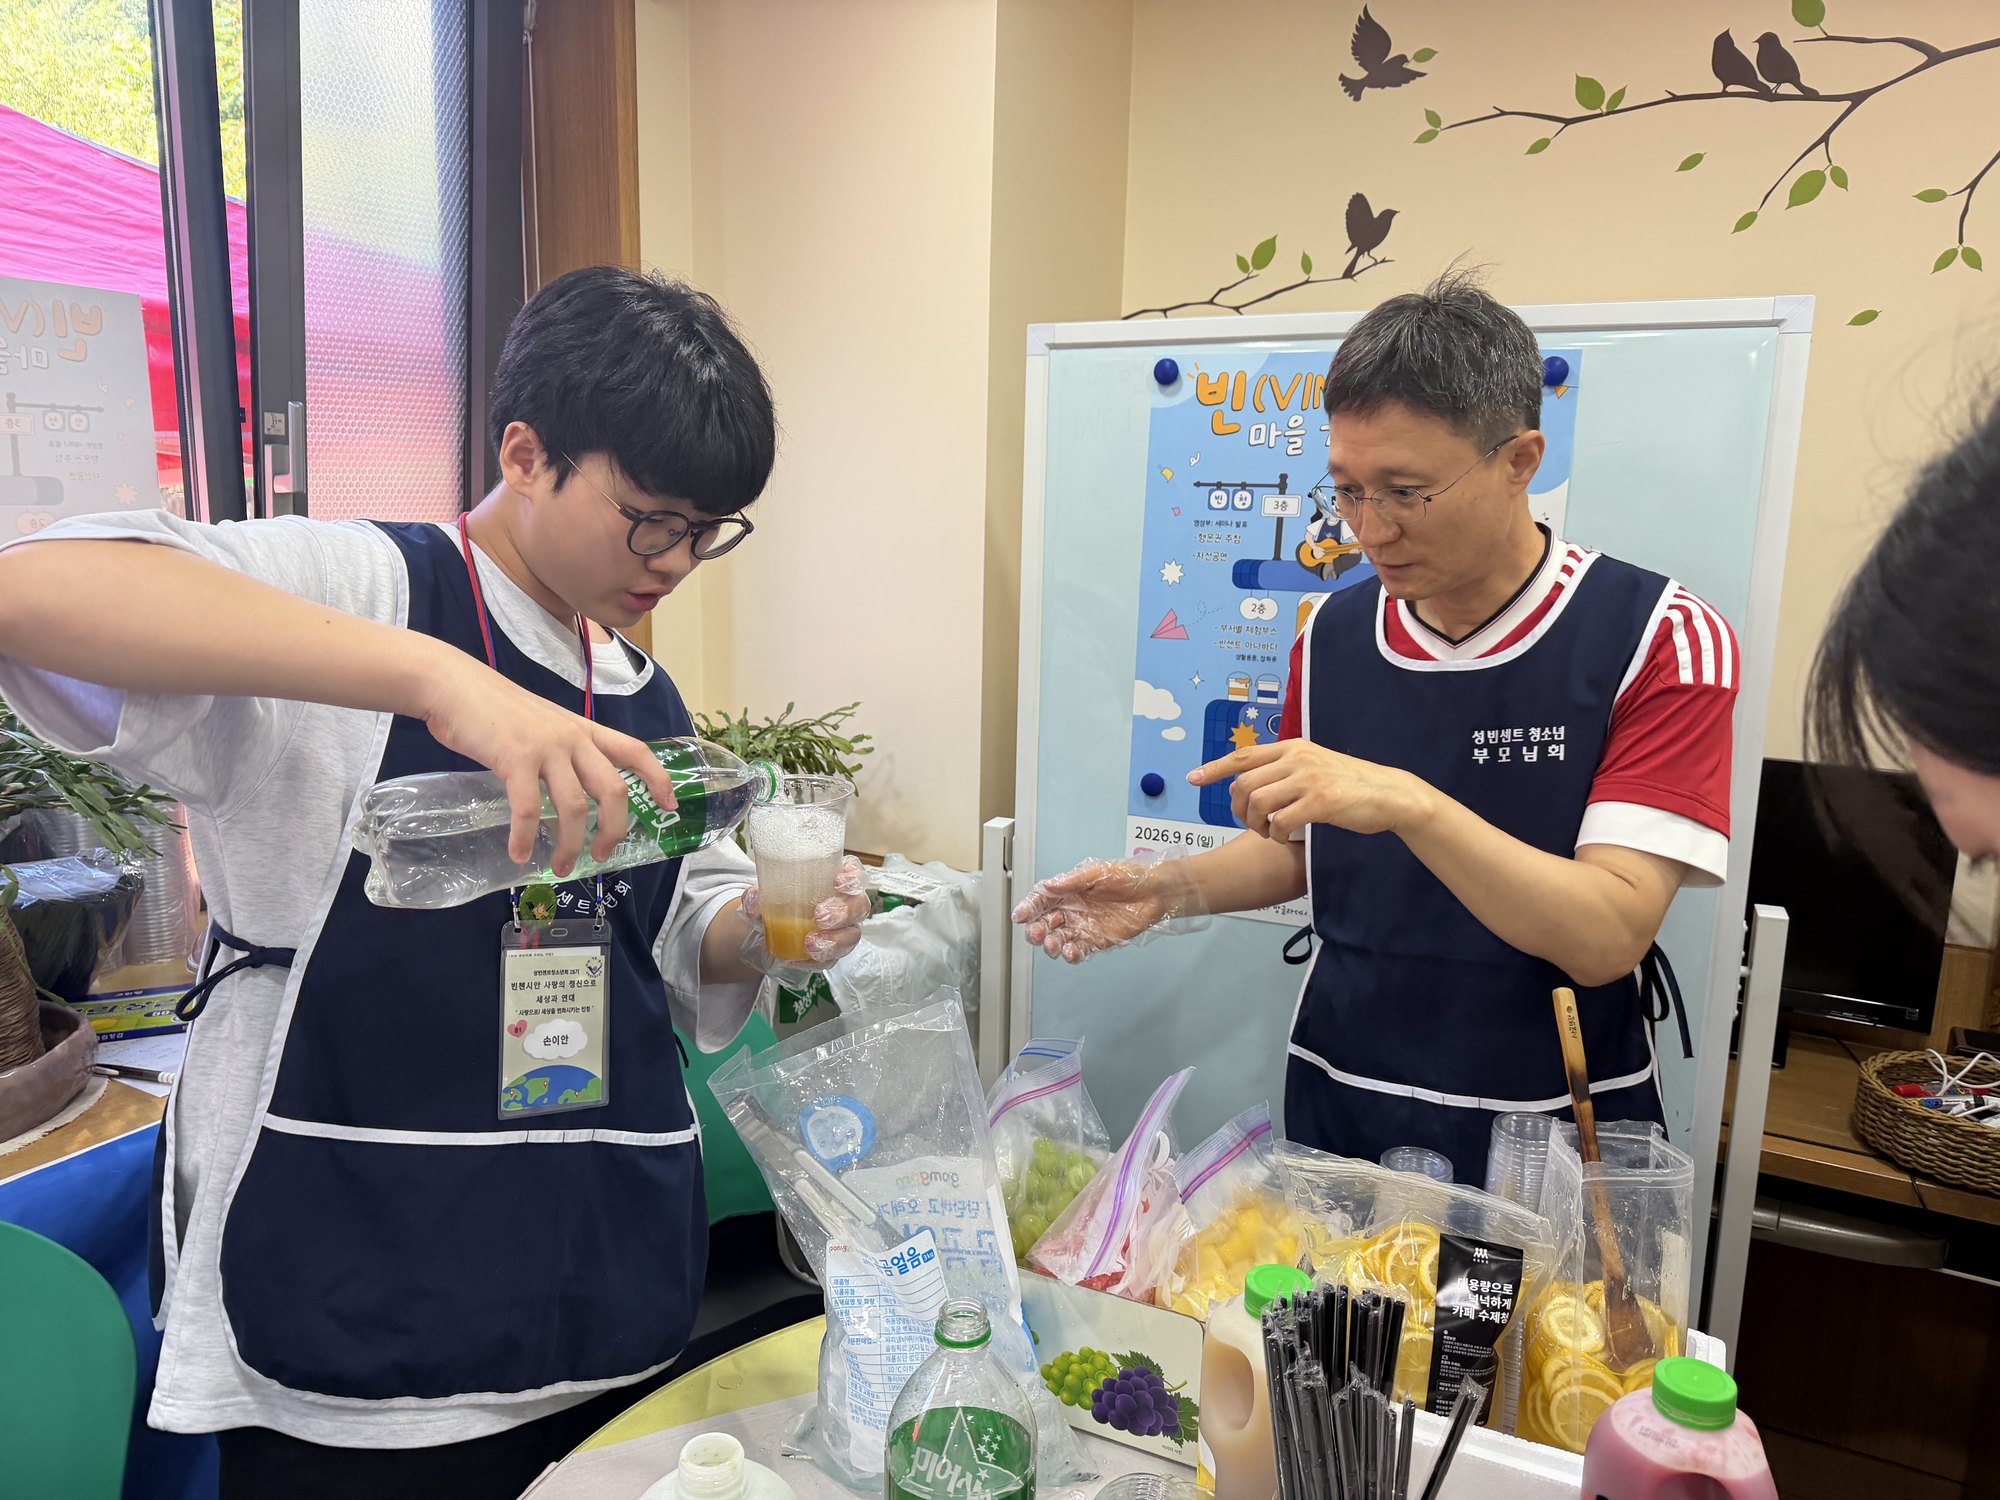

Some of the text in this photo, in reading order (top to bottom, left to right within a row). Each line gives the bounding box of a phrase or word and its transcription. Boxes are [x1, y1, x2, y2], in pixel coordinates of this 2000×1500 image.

[1248, 414, 1307, 456] 마을
[1214, 494, 1223, 505] 빈
[1273, 500, 1289, 512] 3층
[1251, 603, 1266, 615] 2층
[1472, 725, 1565, 745] 성빈센트 청소년
[544, 980, 565, 989] 사랑의
[536, 994, 575, 1003] 세상과 연대
[543, 1034, 569, 1047] 손이안
[1468, 1293, 1512, 1310] 넉넉하게
[1452, 1305, 1510, 1324] 카페 수제청
